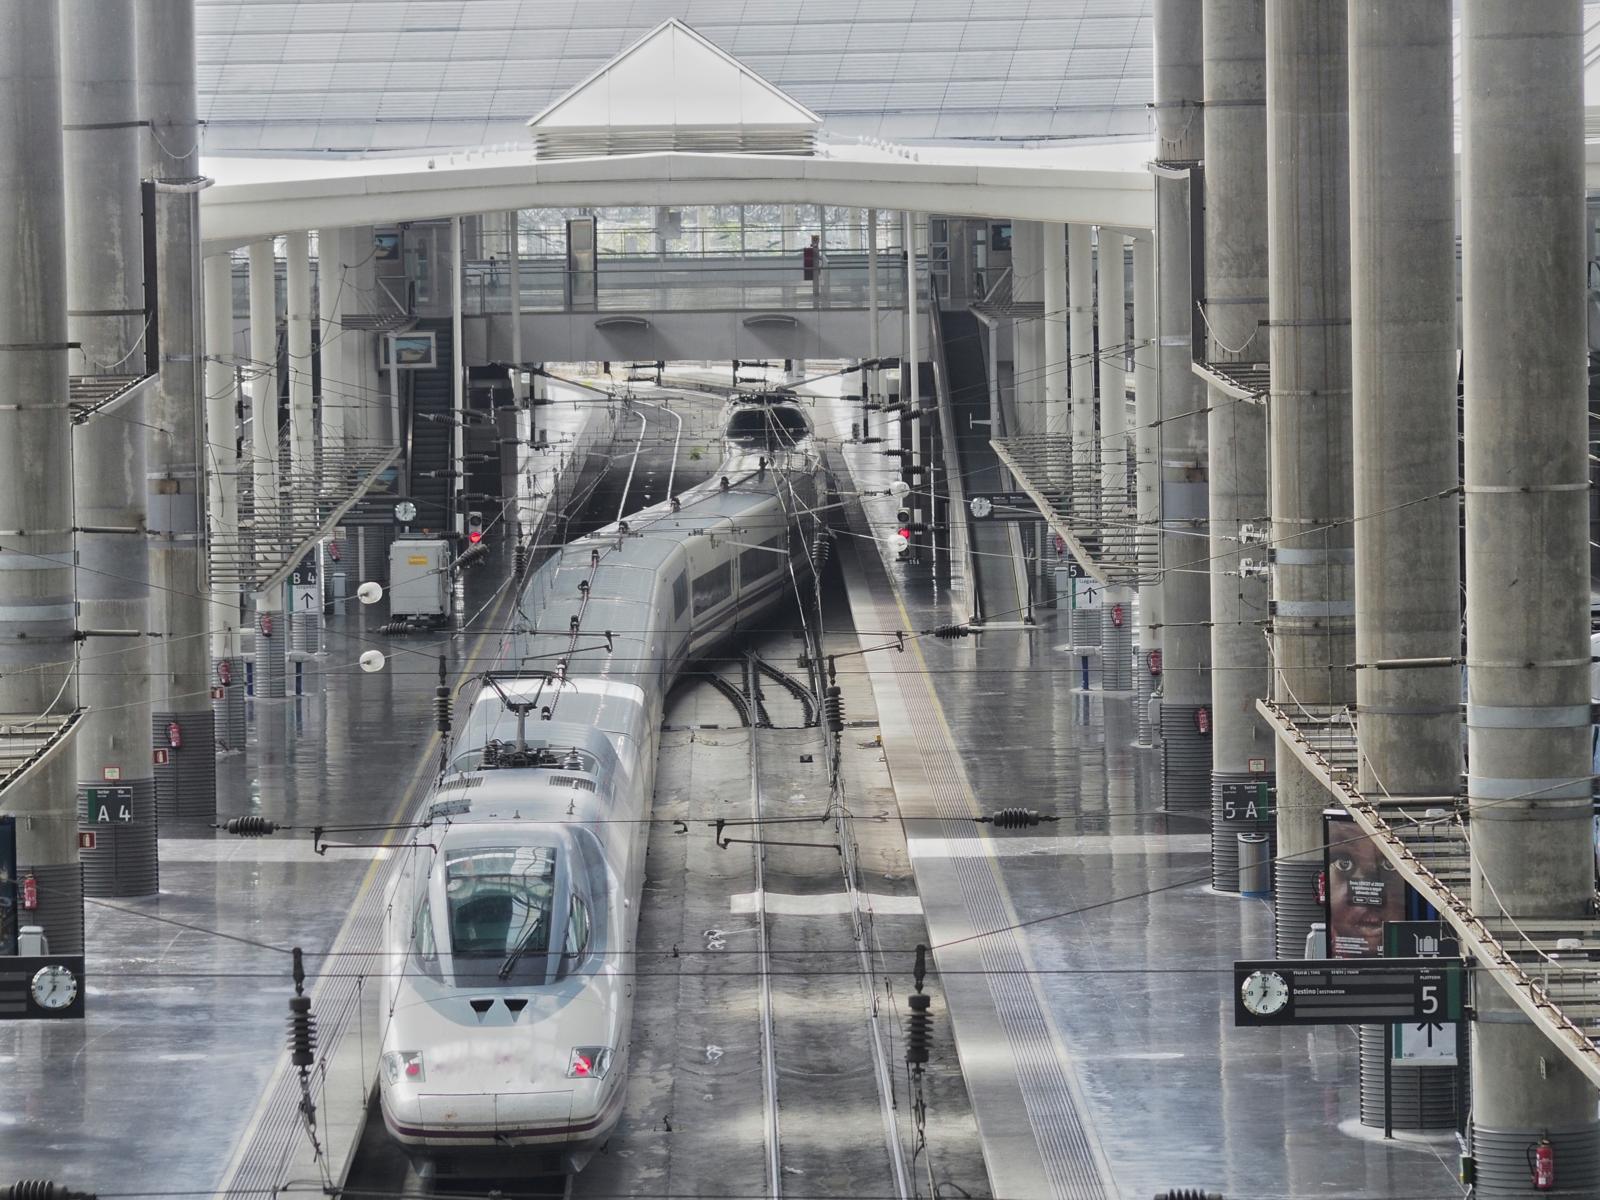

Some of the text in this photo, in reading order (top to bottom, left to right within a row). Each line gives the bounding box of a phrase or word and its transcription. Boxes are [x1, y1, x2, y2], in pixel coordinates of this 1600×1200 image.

[293, 572, 316, 584] B 4
[1070, 565, 1077, 577] 5
[97, 804, 131, 822] A 4
[1225, 801, 1258, 819] 5 A
[1293, 987, 1316, 995] Destino
[1422, 985, 1439, 1014] 5
